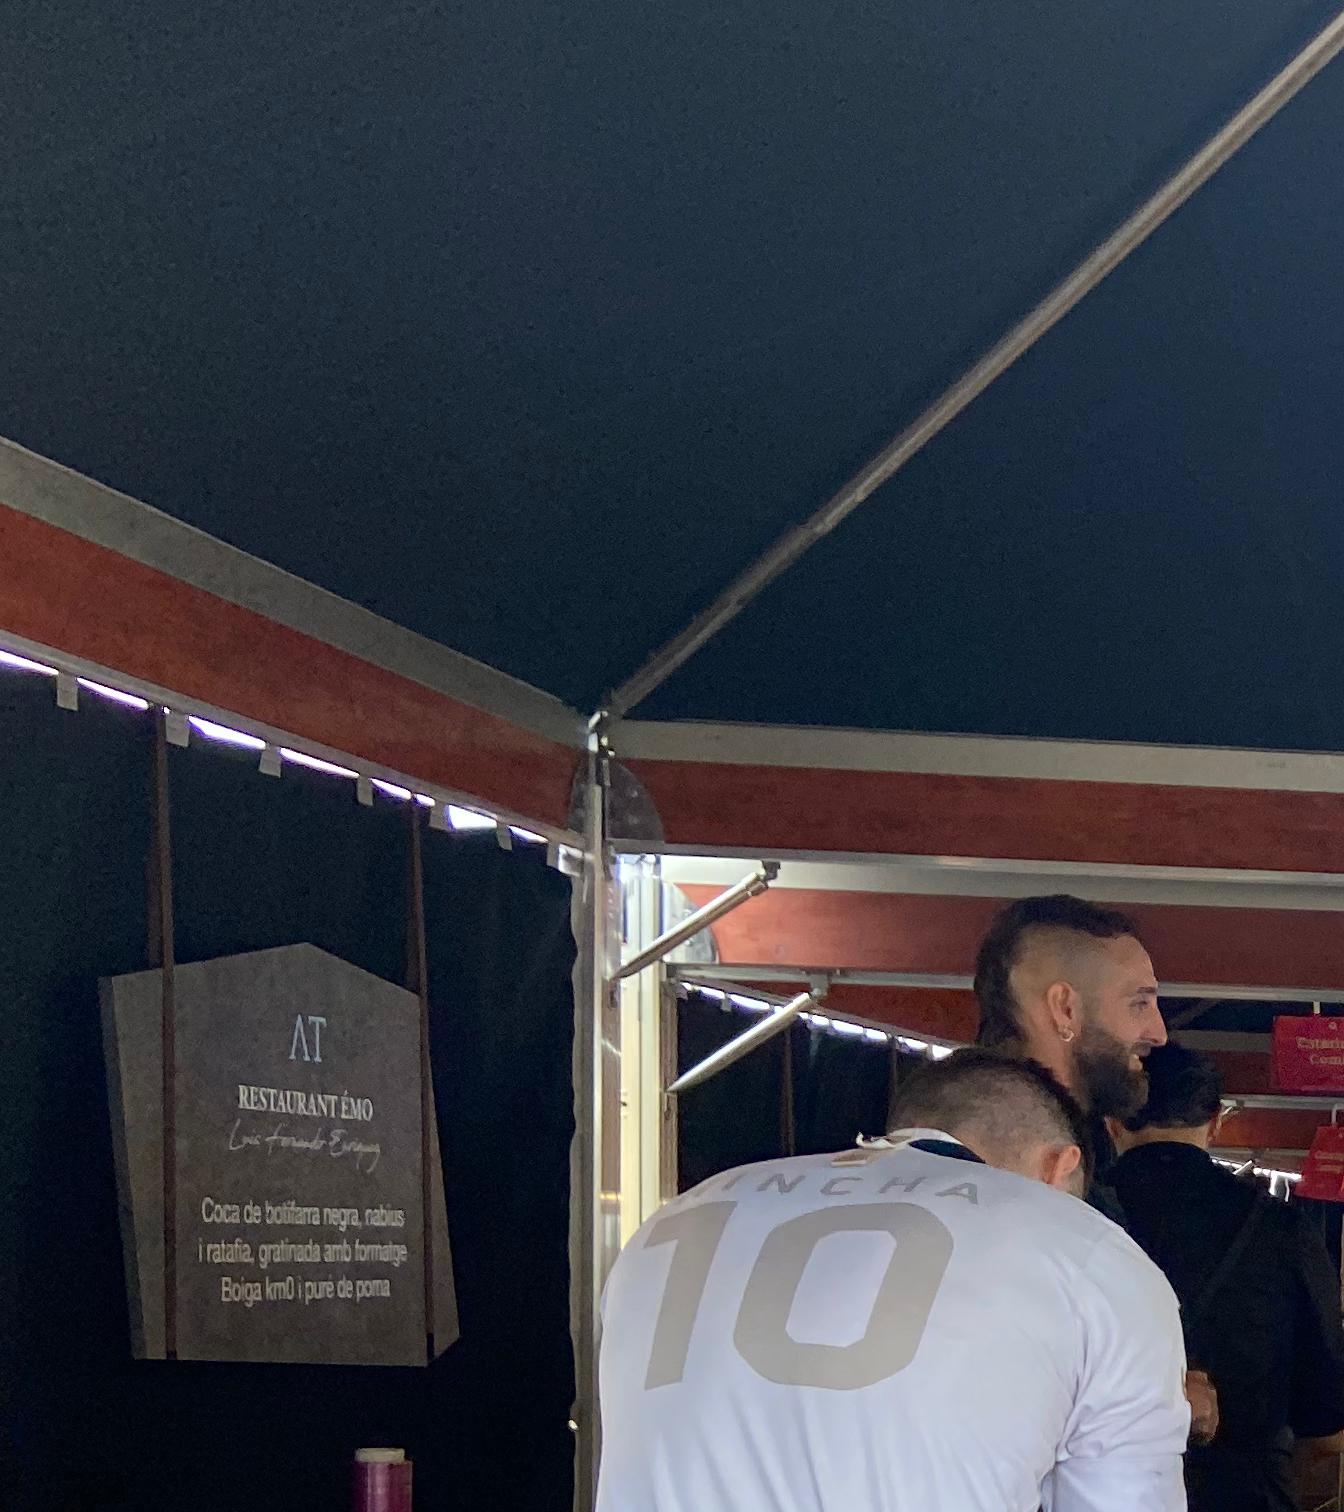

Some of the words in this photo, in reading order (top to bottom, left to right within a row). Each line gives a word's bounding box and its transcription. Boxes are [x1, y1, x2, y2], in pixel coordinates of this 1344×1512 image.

[238, 1084, 338, 1118] RESTAURANT
[340, 1089, 374, 1122] ÉMO
[201, 1196, 240, 1224] Coca
[243, 1199, 261, 1224] de
[265, 1199, 320, 1226] botifarra
[323, 1205, 362, 1232] negra,
[206, 1237, 255, 1264] ratafia,
[258, 1237, 321, 1269] gratinada
[323, 1238, 351, 1263] amb
[354, 1238, 408, 1267] formatge
[337, 1275, 354, 1299] de
[356, 1279, 391, 1304] poma
[643, 1200, 955, 1391] 10
